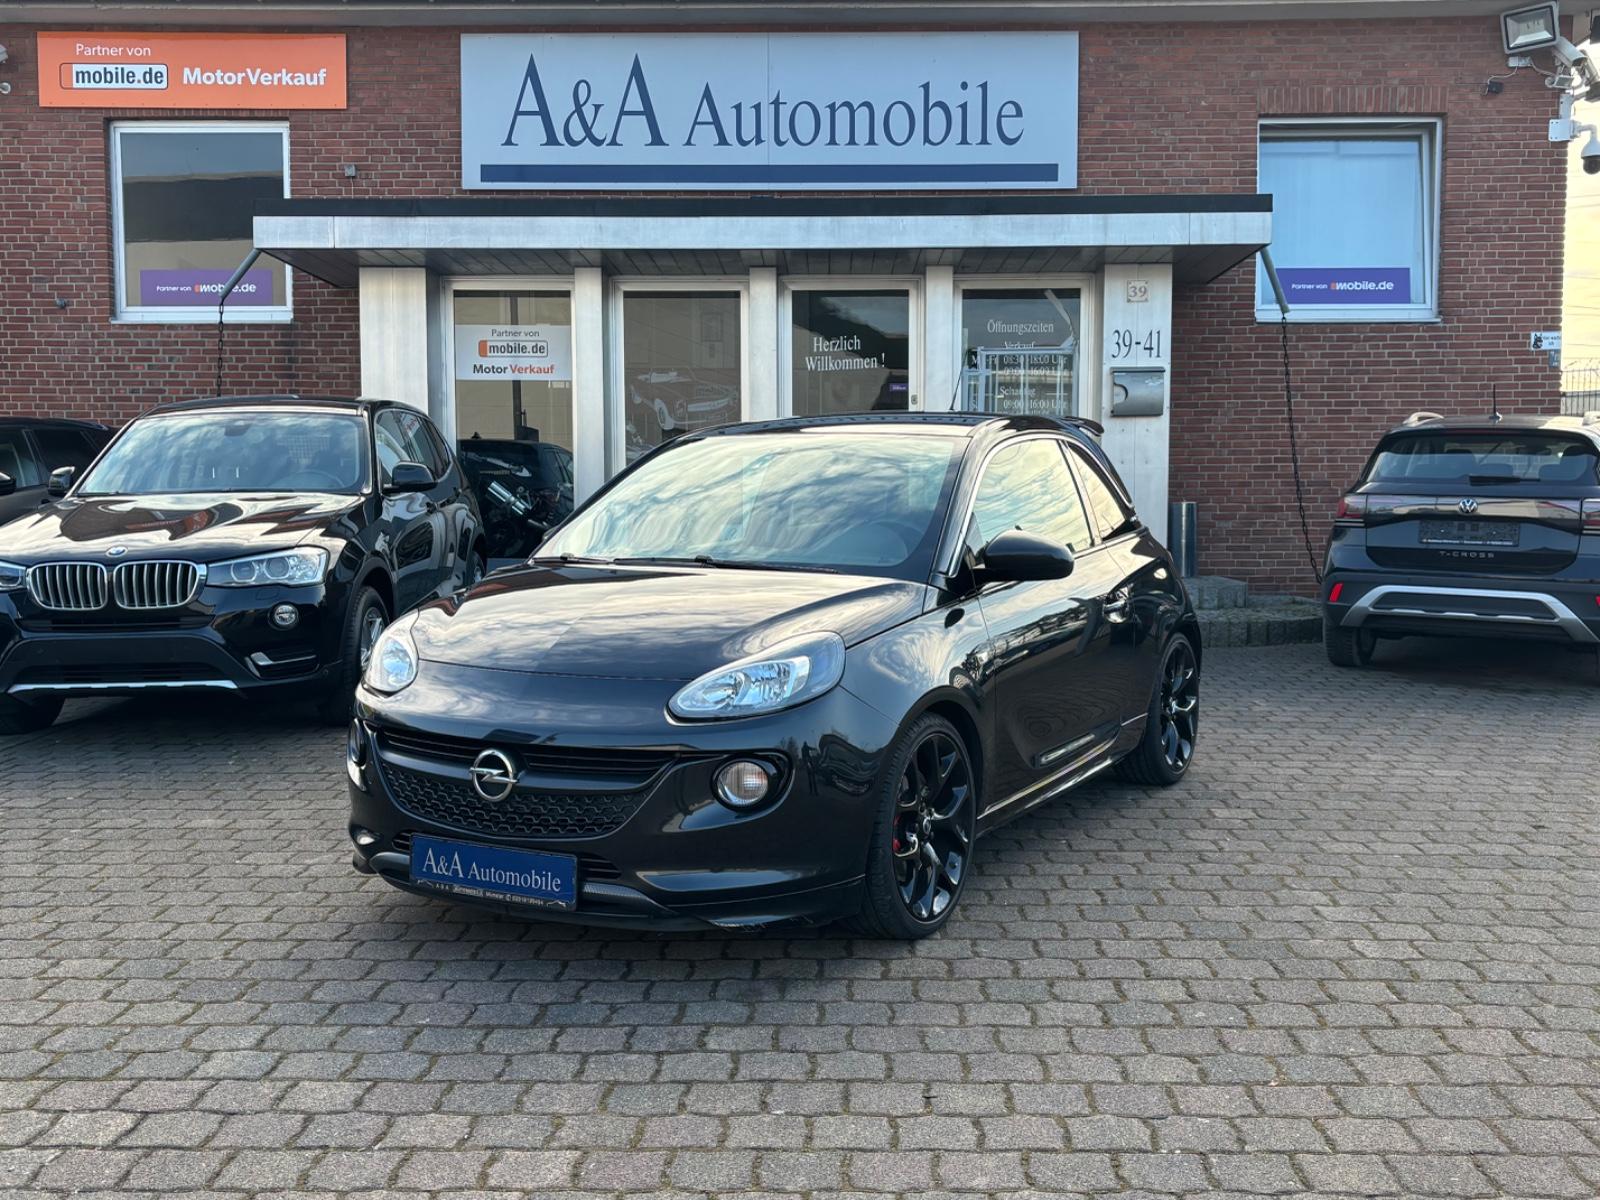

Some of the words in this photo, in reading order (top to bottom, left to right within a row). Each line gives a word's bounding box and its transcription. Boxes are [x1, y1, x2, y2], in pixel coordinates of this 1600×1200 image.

[76, 44, 122, 56] Partner
[127, 46, 151, 56] von
[75, 67, 164, 84] mobile.de
[501, 53, 669, 146] A&A
[682, 80, 1025, 147] Automobile
[200, 283, 257, 293] mobe.de
[1128, 286, 1147, 298] 39
[1335, 281, 1394, 290] mobile.de
[491, 329, 521, 337] Partner
[987, 319, 1054, 335] Öffnungszeiten
[489, 343, 546, 354] mobile.de
[813, 335, 861, 353] Herzlich
[1111, 329, 1161, 358] 39-41
[805, 355, 878, 371] Willkommen
[422, 848, 464, 878] A&A
[467, 862, 561, 892] Automobile
